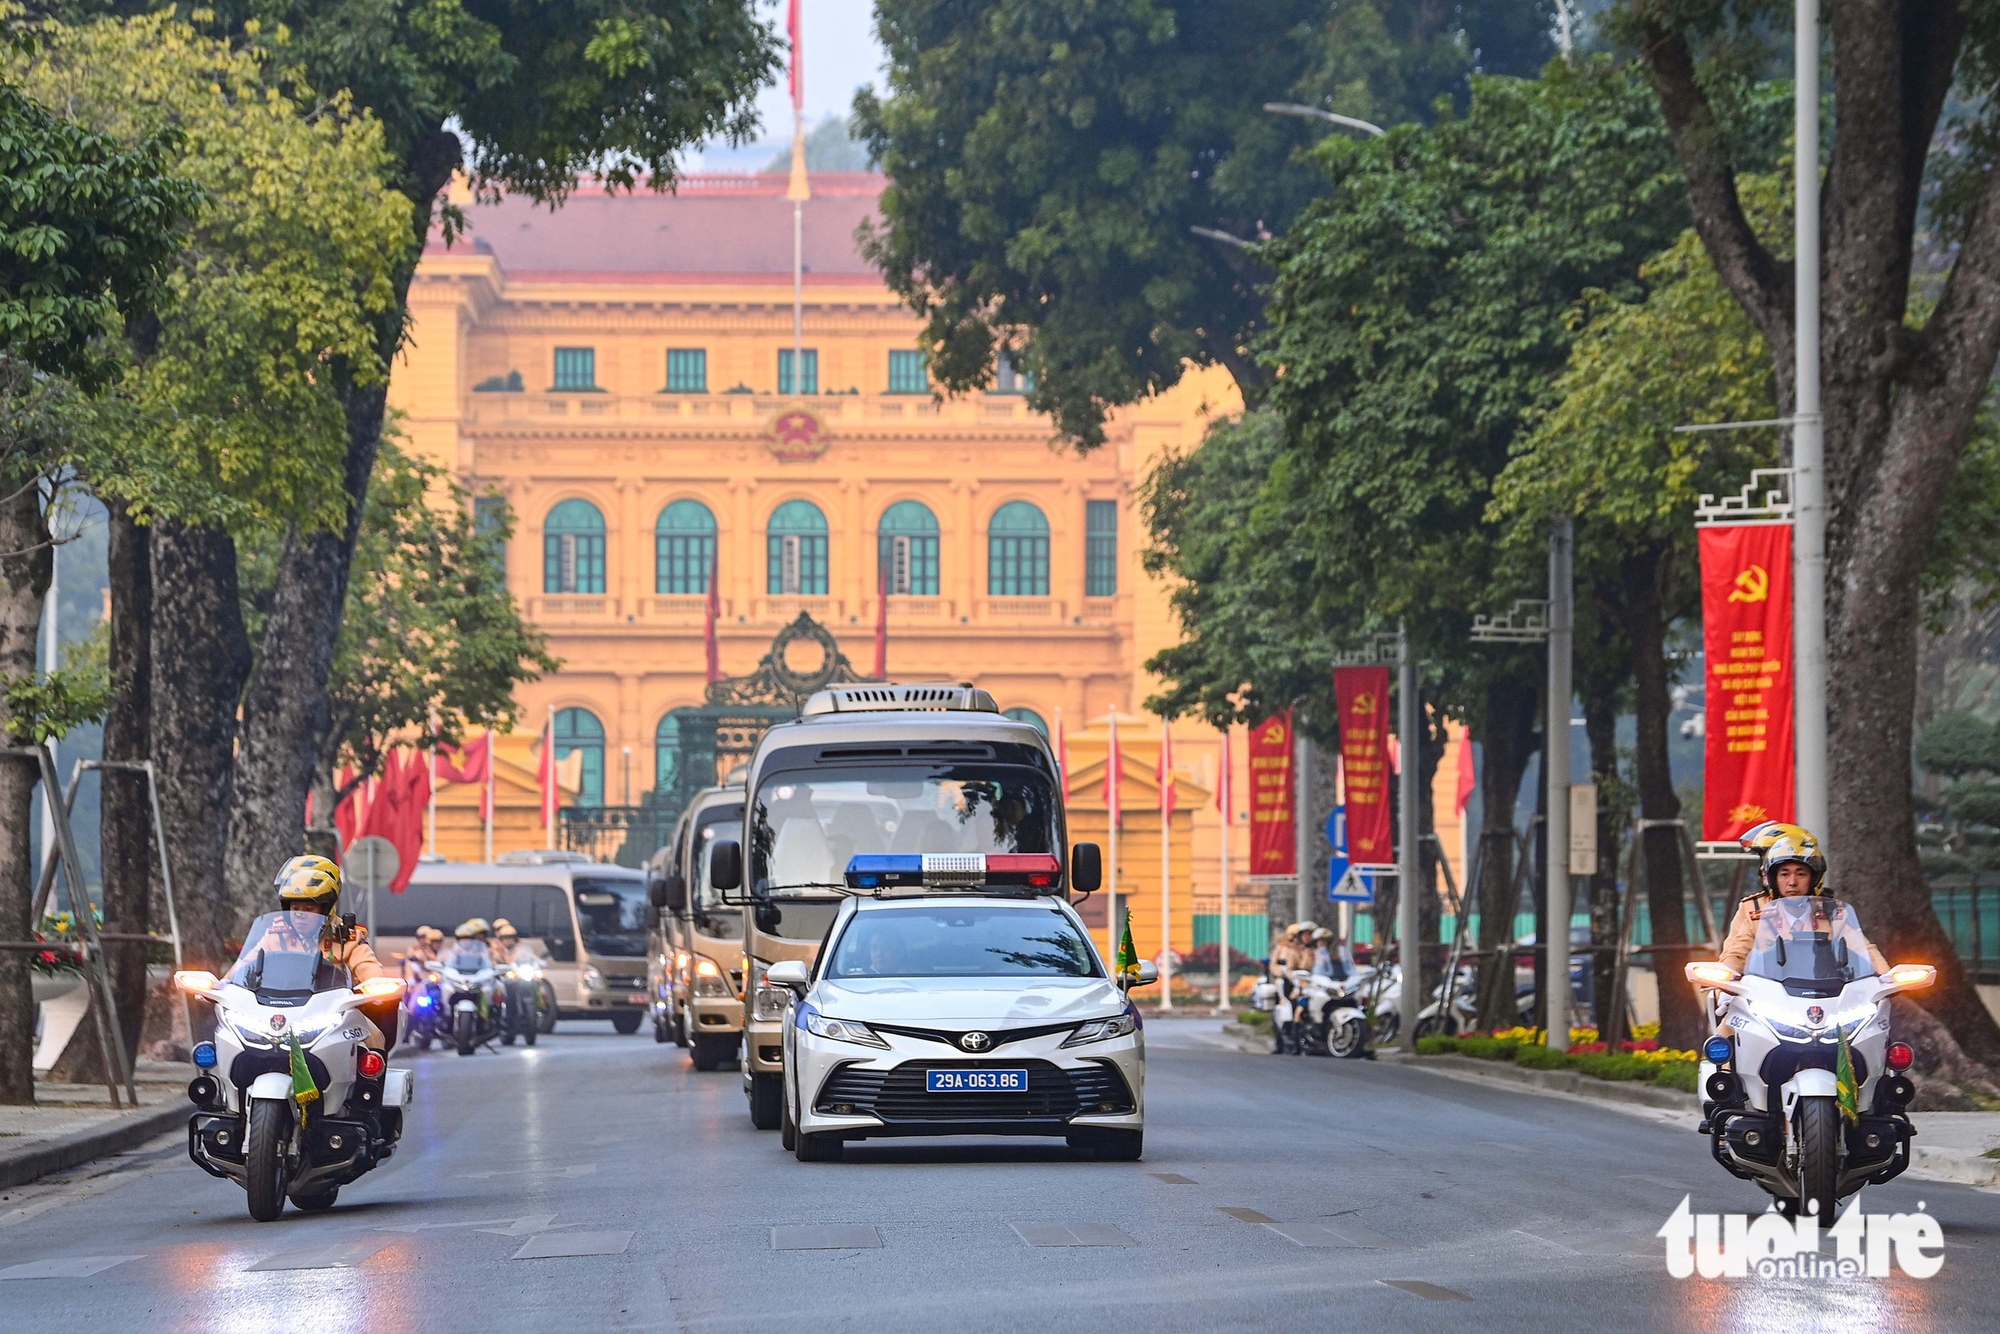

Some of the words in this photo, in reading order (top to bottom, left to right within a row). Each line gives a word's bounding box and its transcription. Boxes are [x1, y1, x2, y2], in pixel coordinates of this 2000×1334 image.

[1730, 1016, 1750, 1029] CSGT
[342, 1027, 364, 1040] CSGT
[935, 1073, 1019, 1088] 29A-063.86
